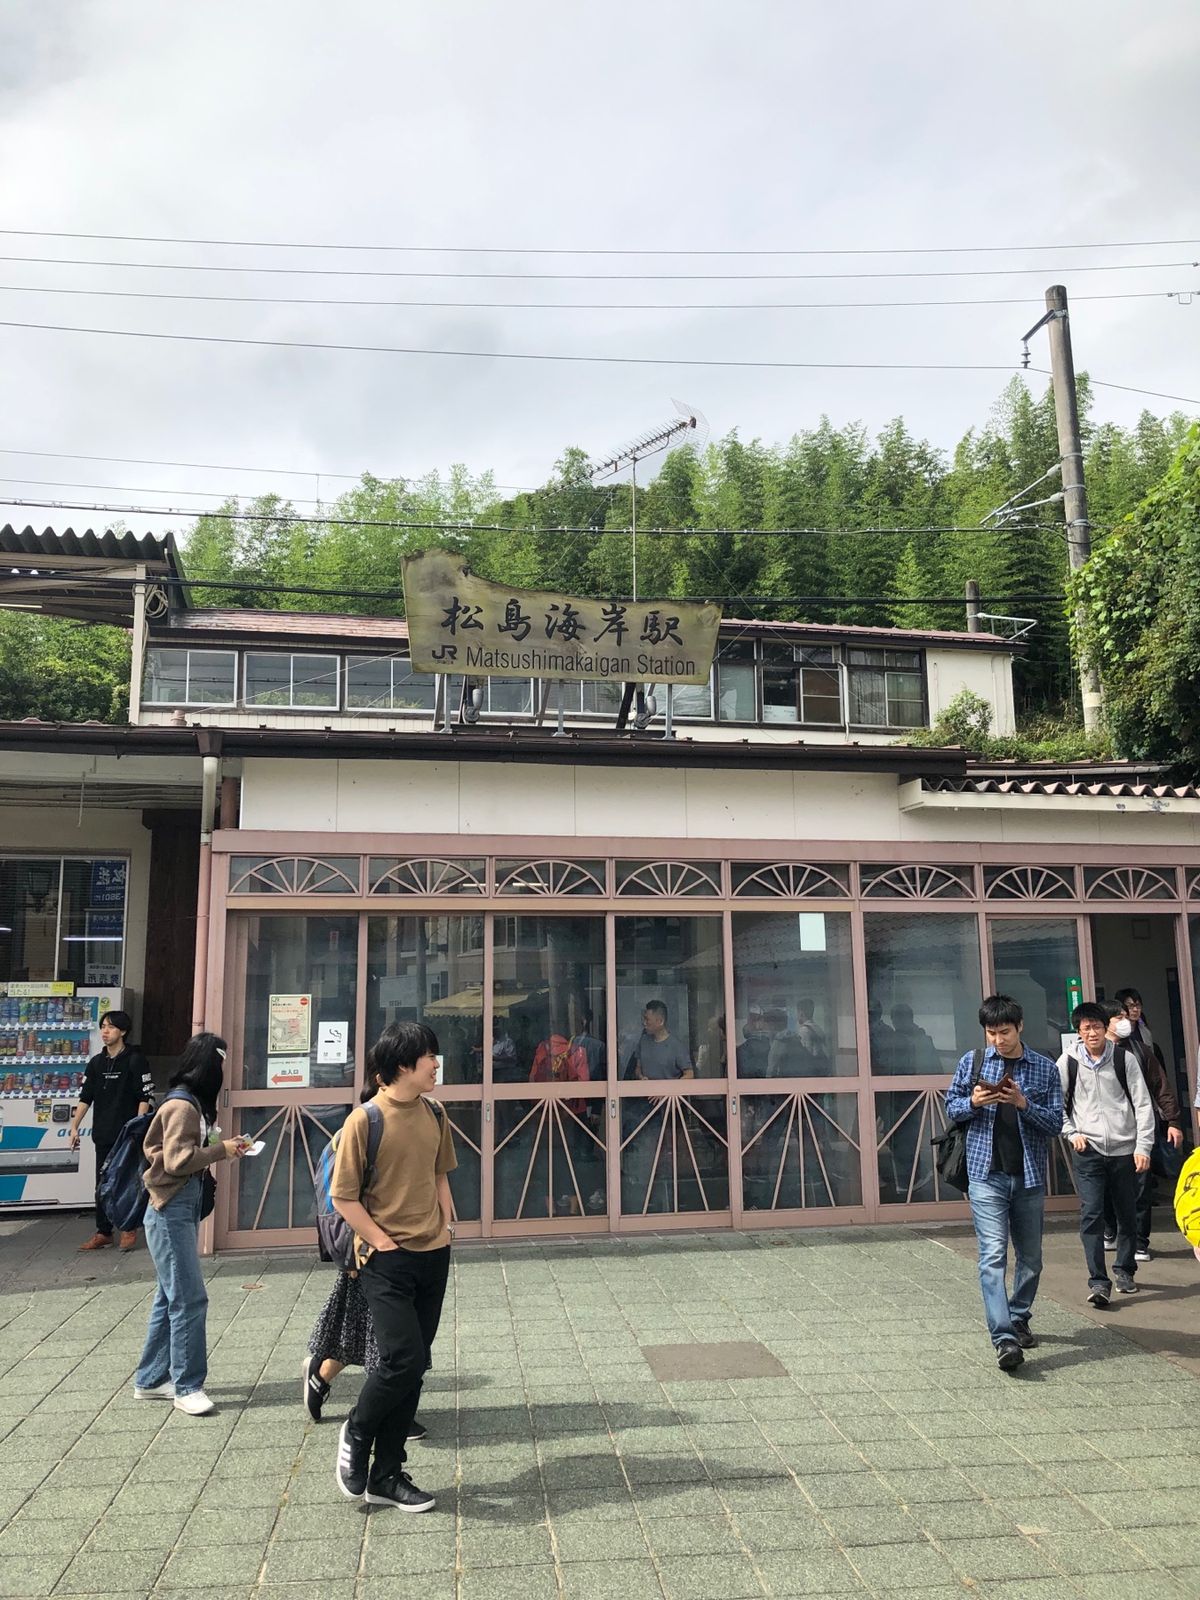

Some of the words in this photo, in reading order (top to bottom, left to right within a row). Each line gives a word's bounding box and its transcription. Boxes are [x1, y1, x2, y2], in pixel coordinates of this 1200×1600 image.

[440, 597, 683, 647] 松島海岸駅
[432, 645, 457, 660] JR
[466, 647, 630, 677] Matsushimakaigan
[637, 653, 695, 676] Station
